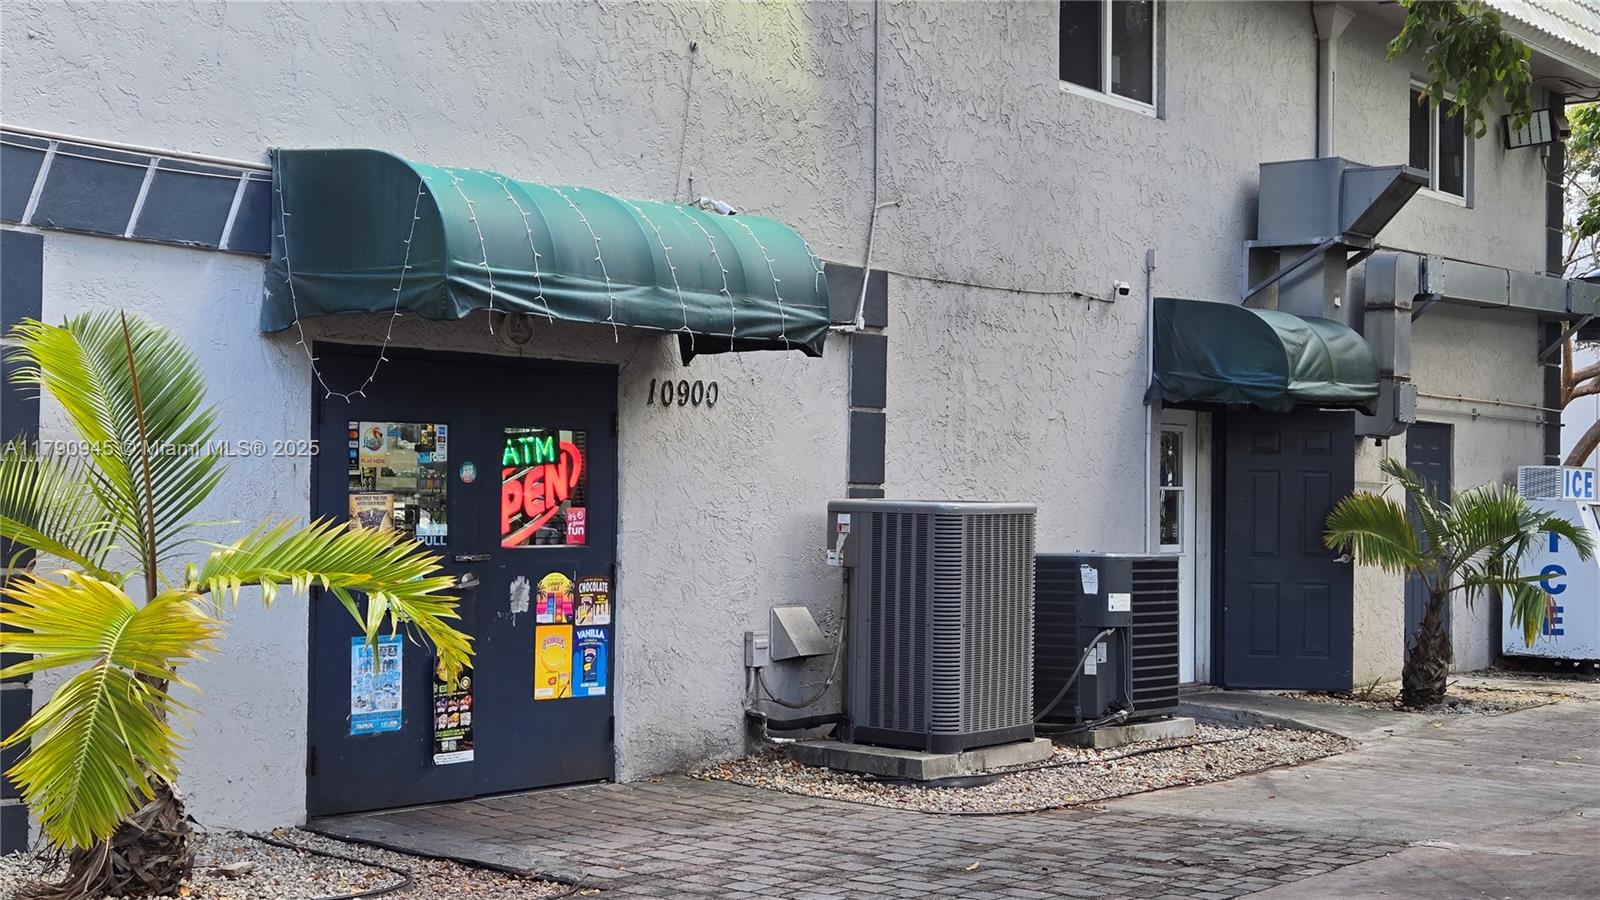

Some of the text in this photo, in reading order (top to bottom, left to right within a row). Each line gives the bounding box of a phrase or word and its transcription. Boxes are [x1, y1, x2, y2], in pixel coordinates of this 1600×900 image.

[647, 378, 718, 408] 10900
[502, 436, 554, 465] ATM
[501, 452, 567, 536] PEN
[1565, 471, 1593, 498] ICE
[568, 522, 584, 536] fun
[579, 581, 608, 593] CHOCOLATE
[577, 628, 605, 639] VANILLA
